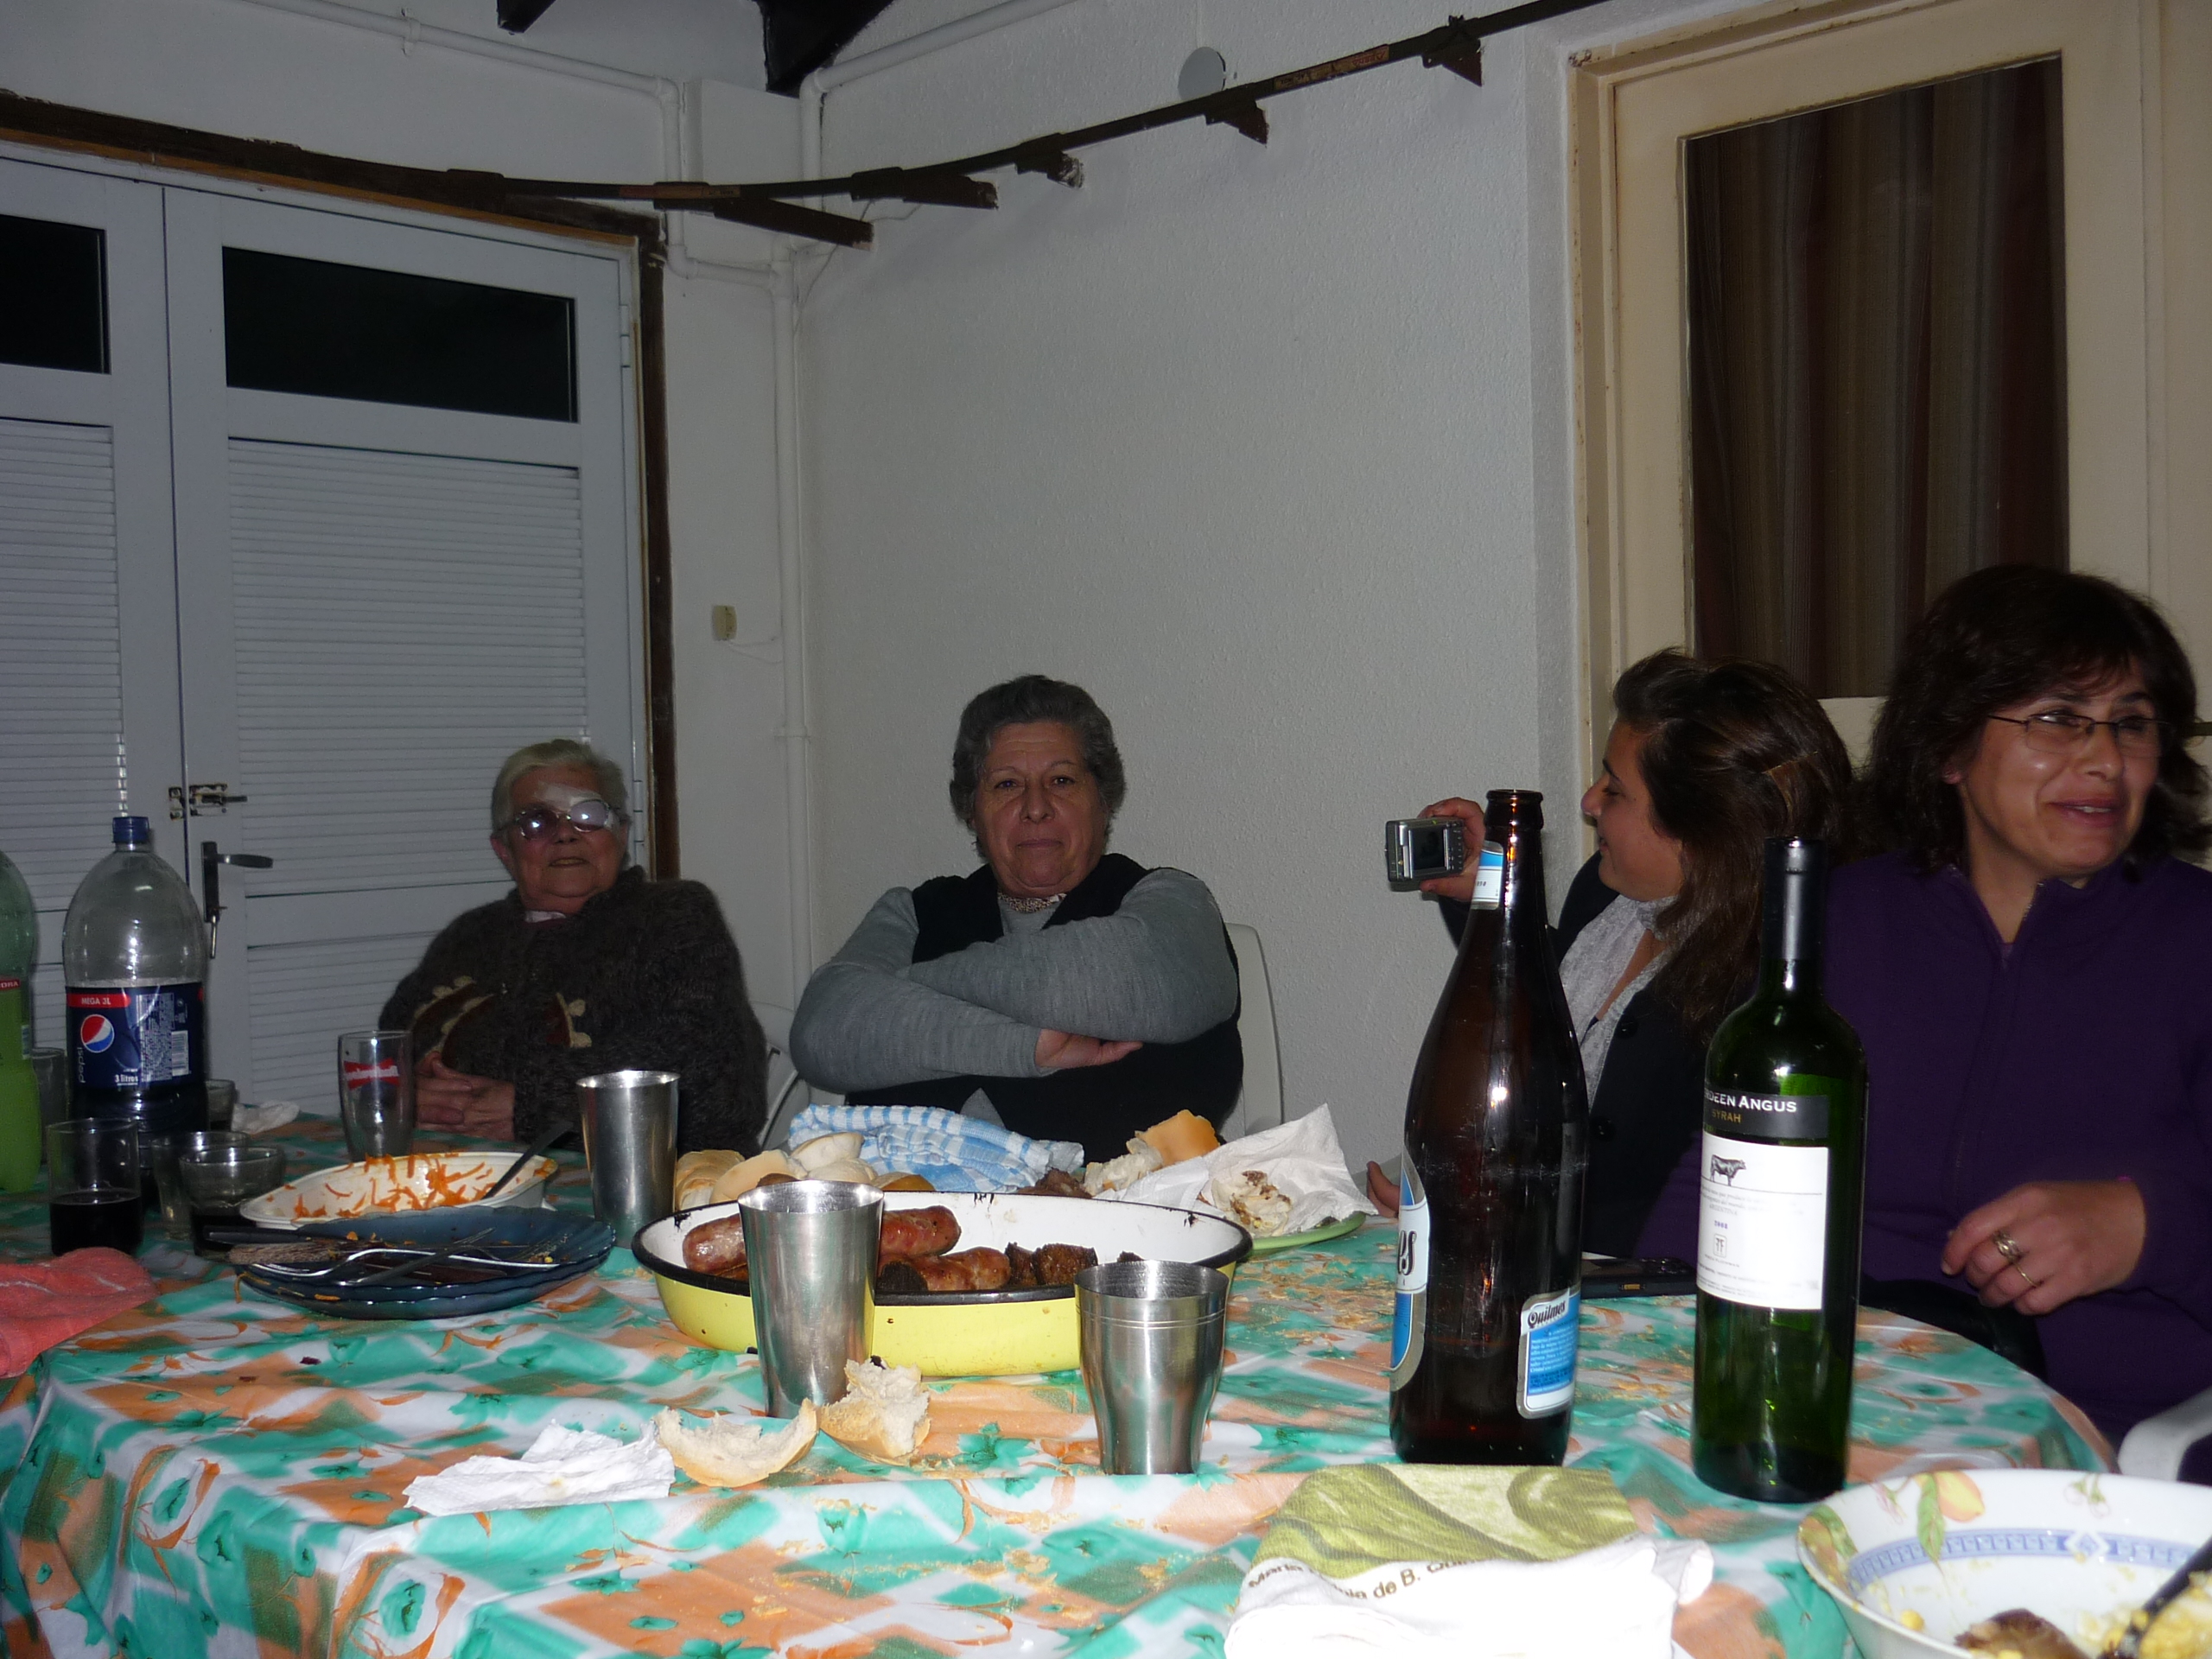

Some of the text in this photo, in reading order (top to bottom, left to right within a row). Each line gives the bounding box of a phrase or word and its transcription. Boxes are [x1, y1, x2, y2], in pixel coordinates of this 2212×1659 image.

[81, 997, 111, 1006] MEGA 3L
[77, 1047, 86, 1084] pepsi
[1738, 1096, 1797, 1113] ANGUS
[1712, 1109, 1742, 1124] SYRAH
[1527, 1300, 1566, 1329] Quilmes
[1372, 1580, 1397, 1599] de
[1400, 1567, 1421, 1588] B.
